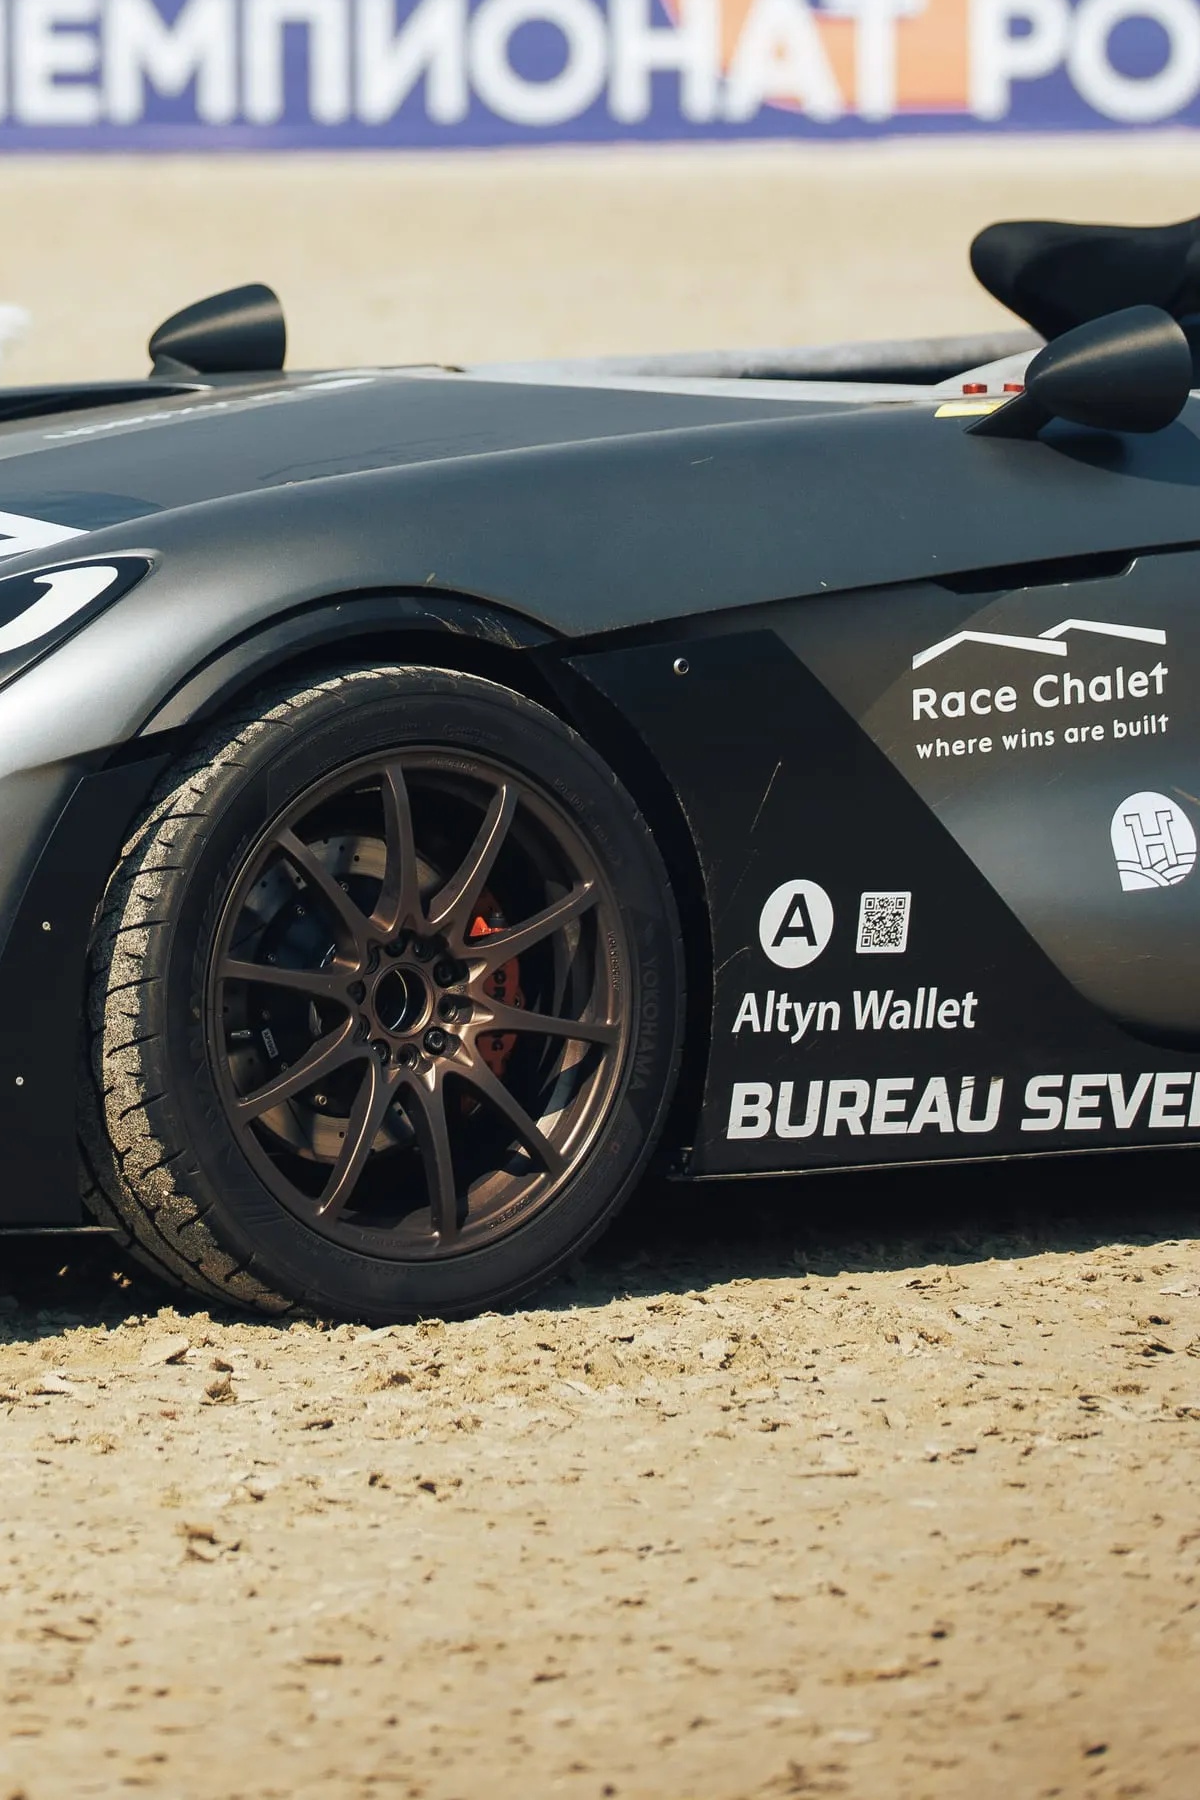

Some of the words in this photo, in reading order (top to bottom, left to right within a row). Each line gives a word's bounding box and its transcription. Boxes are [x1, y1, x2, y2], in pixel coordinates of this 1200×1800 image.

[912, 686, 1017, 721] Race
[1033, 661, 1169, 708] Chalet
[916, 736, 993, 759] where
[1002, 728, 1055, 750] wins
[1064, 724, 1105, 744] are
[1113, 713, 1169, 738] built
[771, 893, 818, 947] A
[629, 958, 660, 1091] YOKOHAMA
[732, 991, 841, 1044] Altyn
[852, 988, 978, 1030] Wallet
[726, 1076, 1004, 1140] BUREAU
